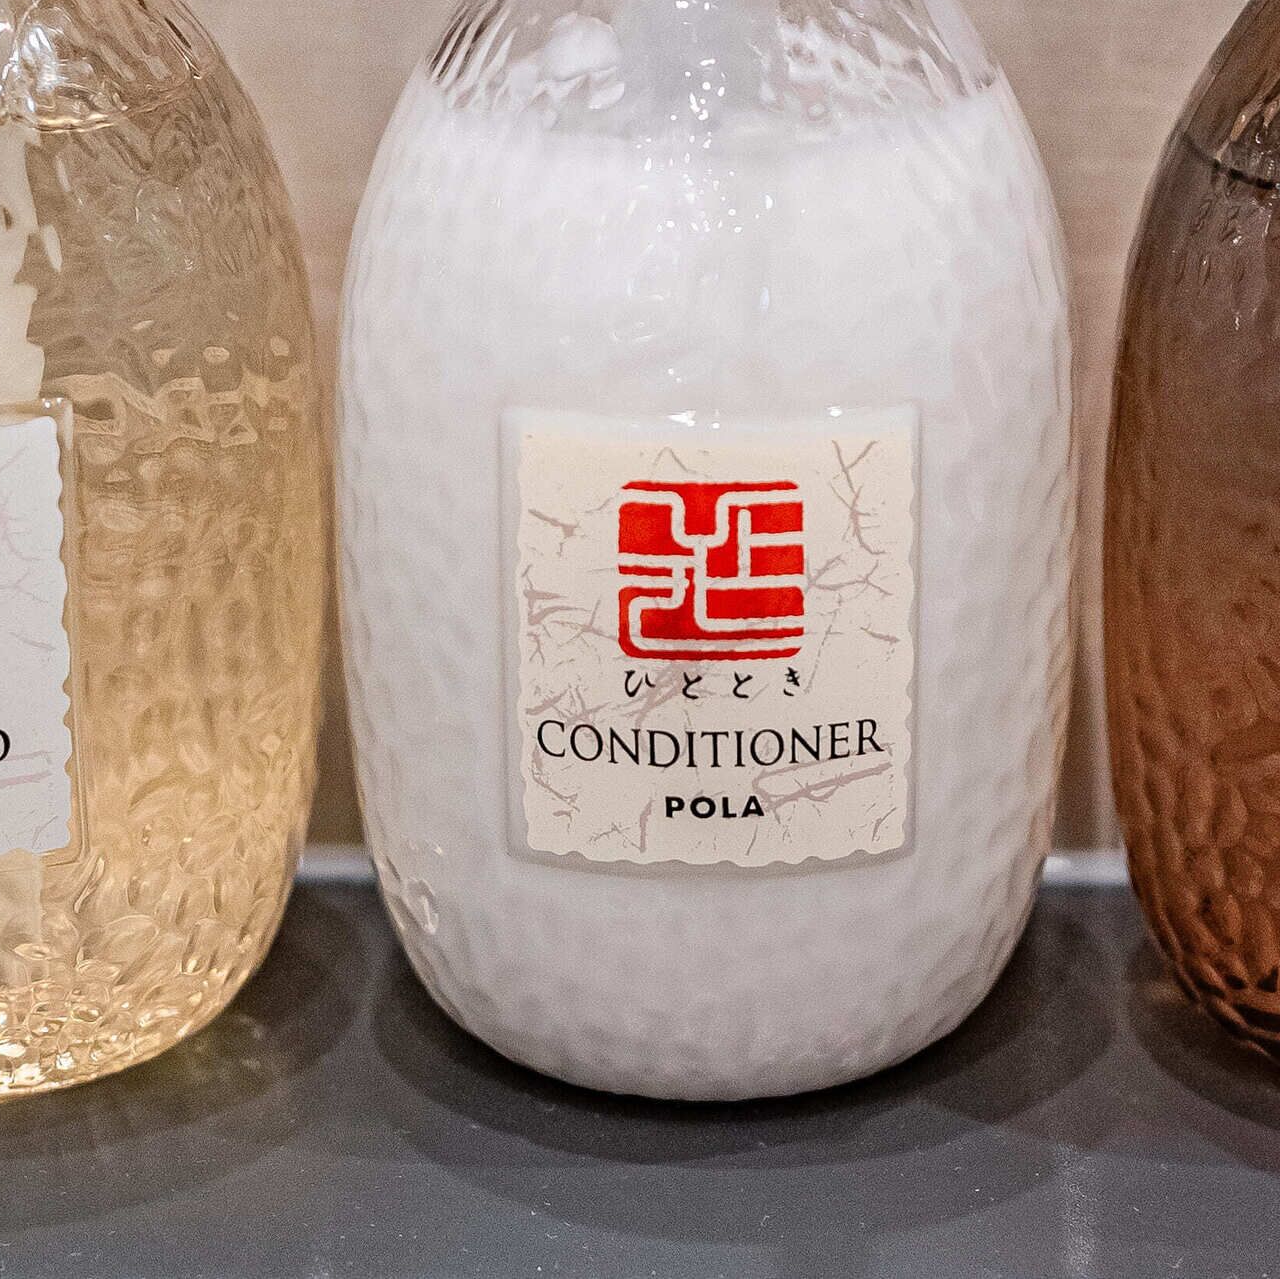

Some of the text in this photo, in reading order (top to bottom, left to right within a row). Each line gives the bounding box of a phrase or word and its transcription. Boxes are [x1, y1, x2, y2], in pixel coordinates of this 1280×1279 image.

[624, 666, 801, 700] ひととき
[536, 718, 886, 769] CONDITIONER
[665, 794, 765, 819] POLA
